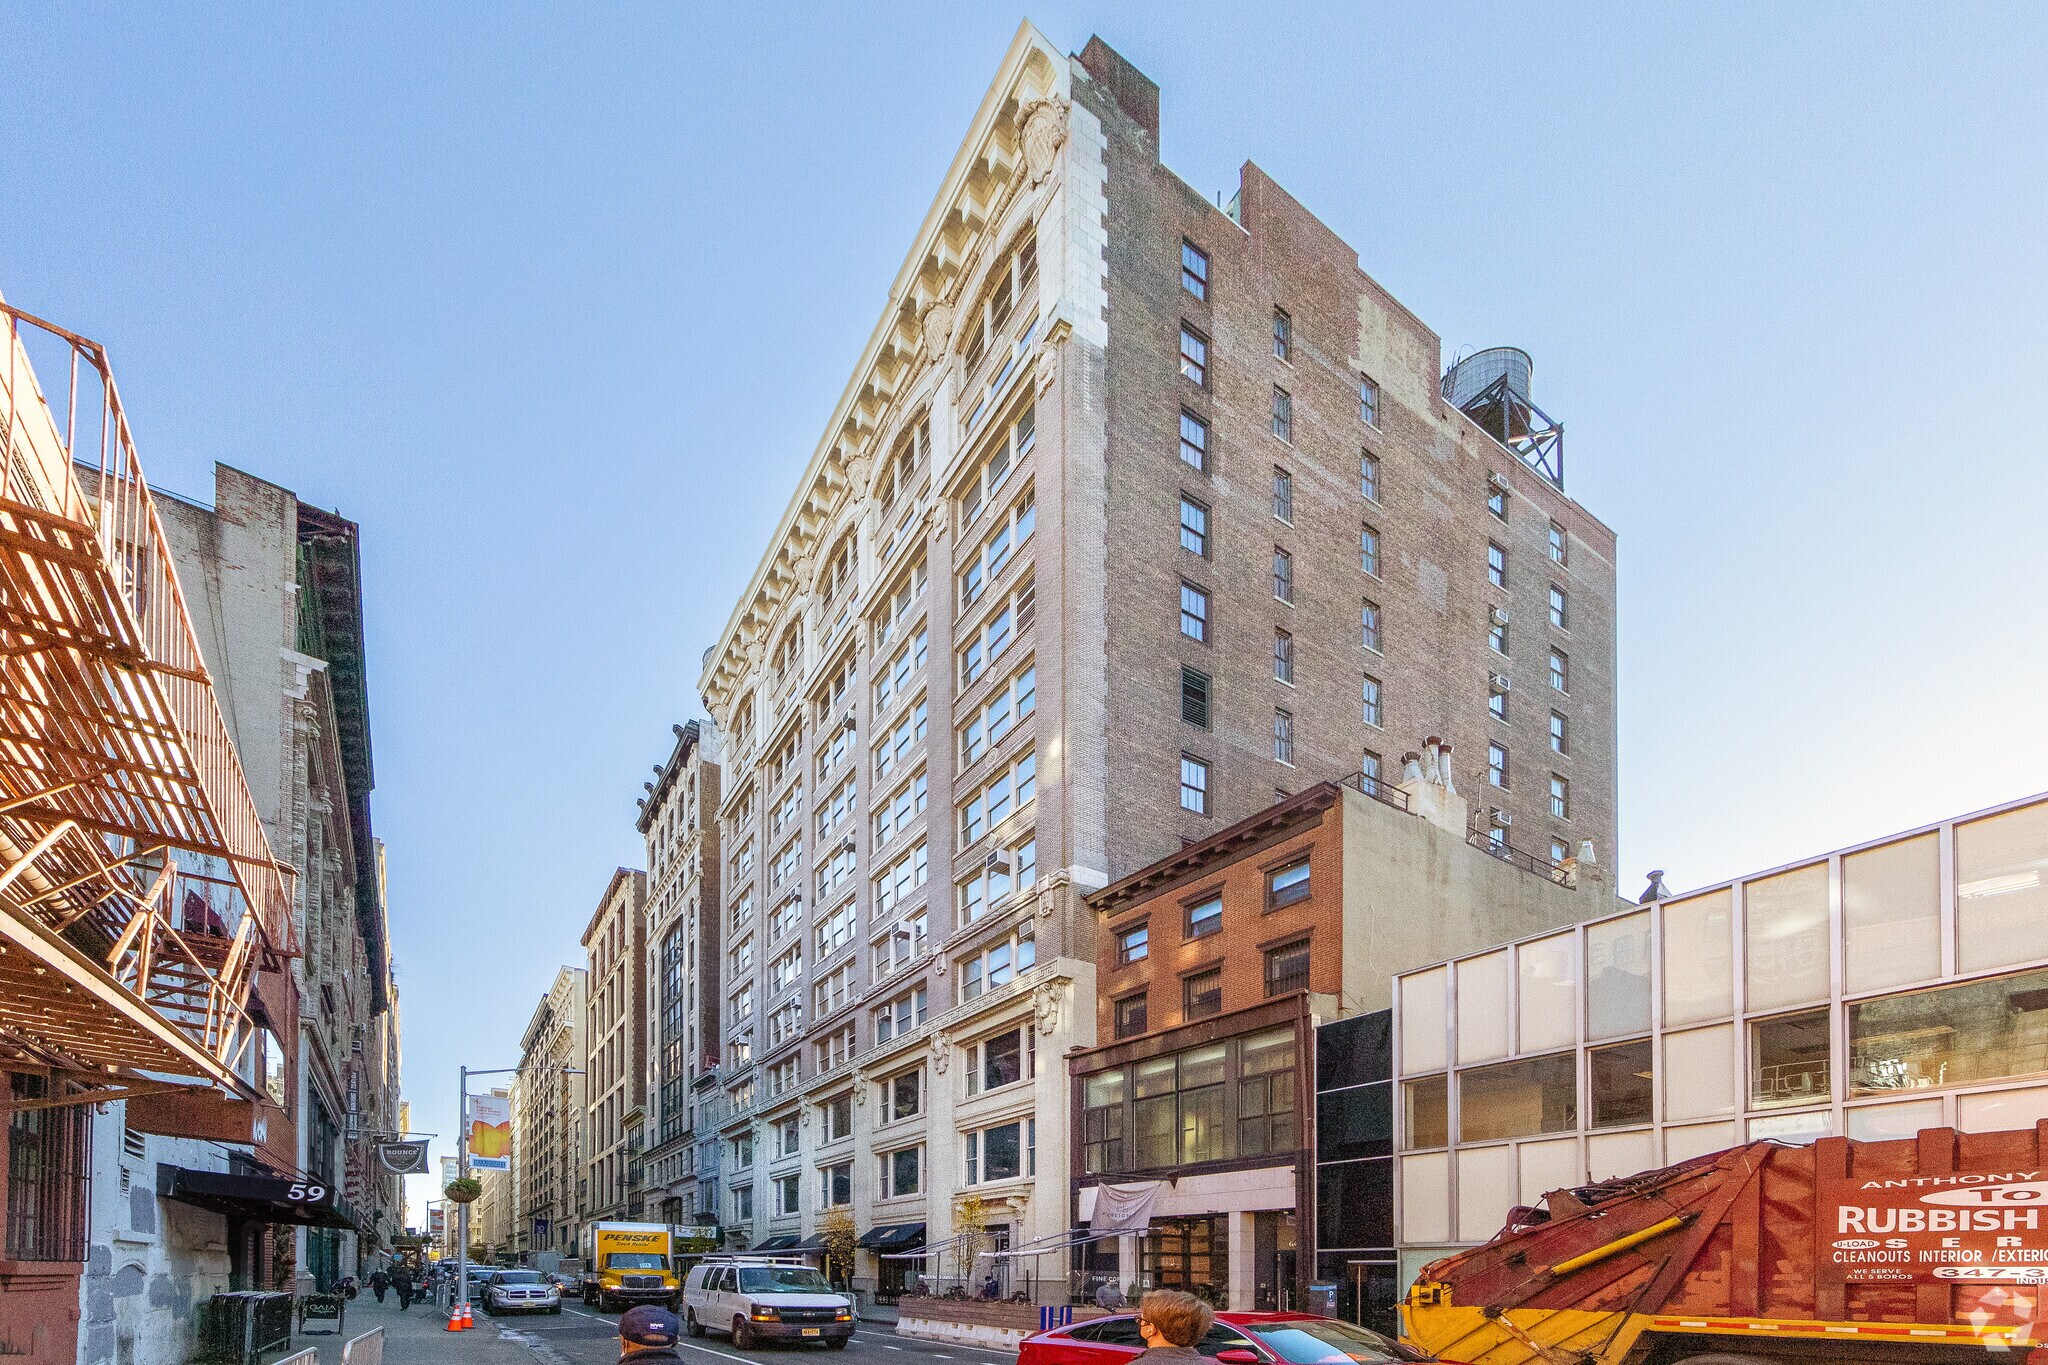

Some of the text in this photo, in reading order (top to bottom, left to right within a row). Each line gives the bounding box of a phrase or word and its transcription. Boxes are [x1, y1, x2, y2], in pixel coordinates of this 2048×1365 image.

[1860, 1171, 2040, 1190] ANTHONY
[287, 1183, 325, 1202] 59
[1838, 1205, 2038, 1234] RUBBISH
[603, 1234, 661, 1242] PENSKE
[1836, 1240, 1875, 1248] U-LOAD
[1833, 1250, 1911, 1263] CLEANOUTS
[1919, 1249, 1983, 1262] INTERIOR
[1941, 1268, 2046, 1278] 347-3
[1329, 1290, 1334, 1298] P
